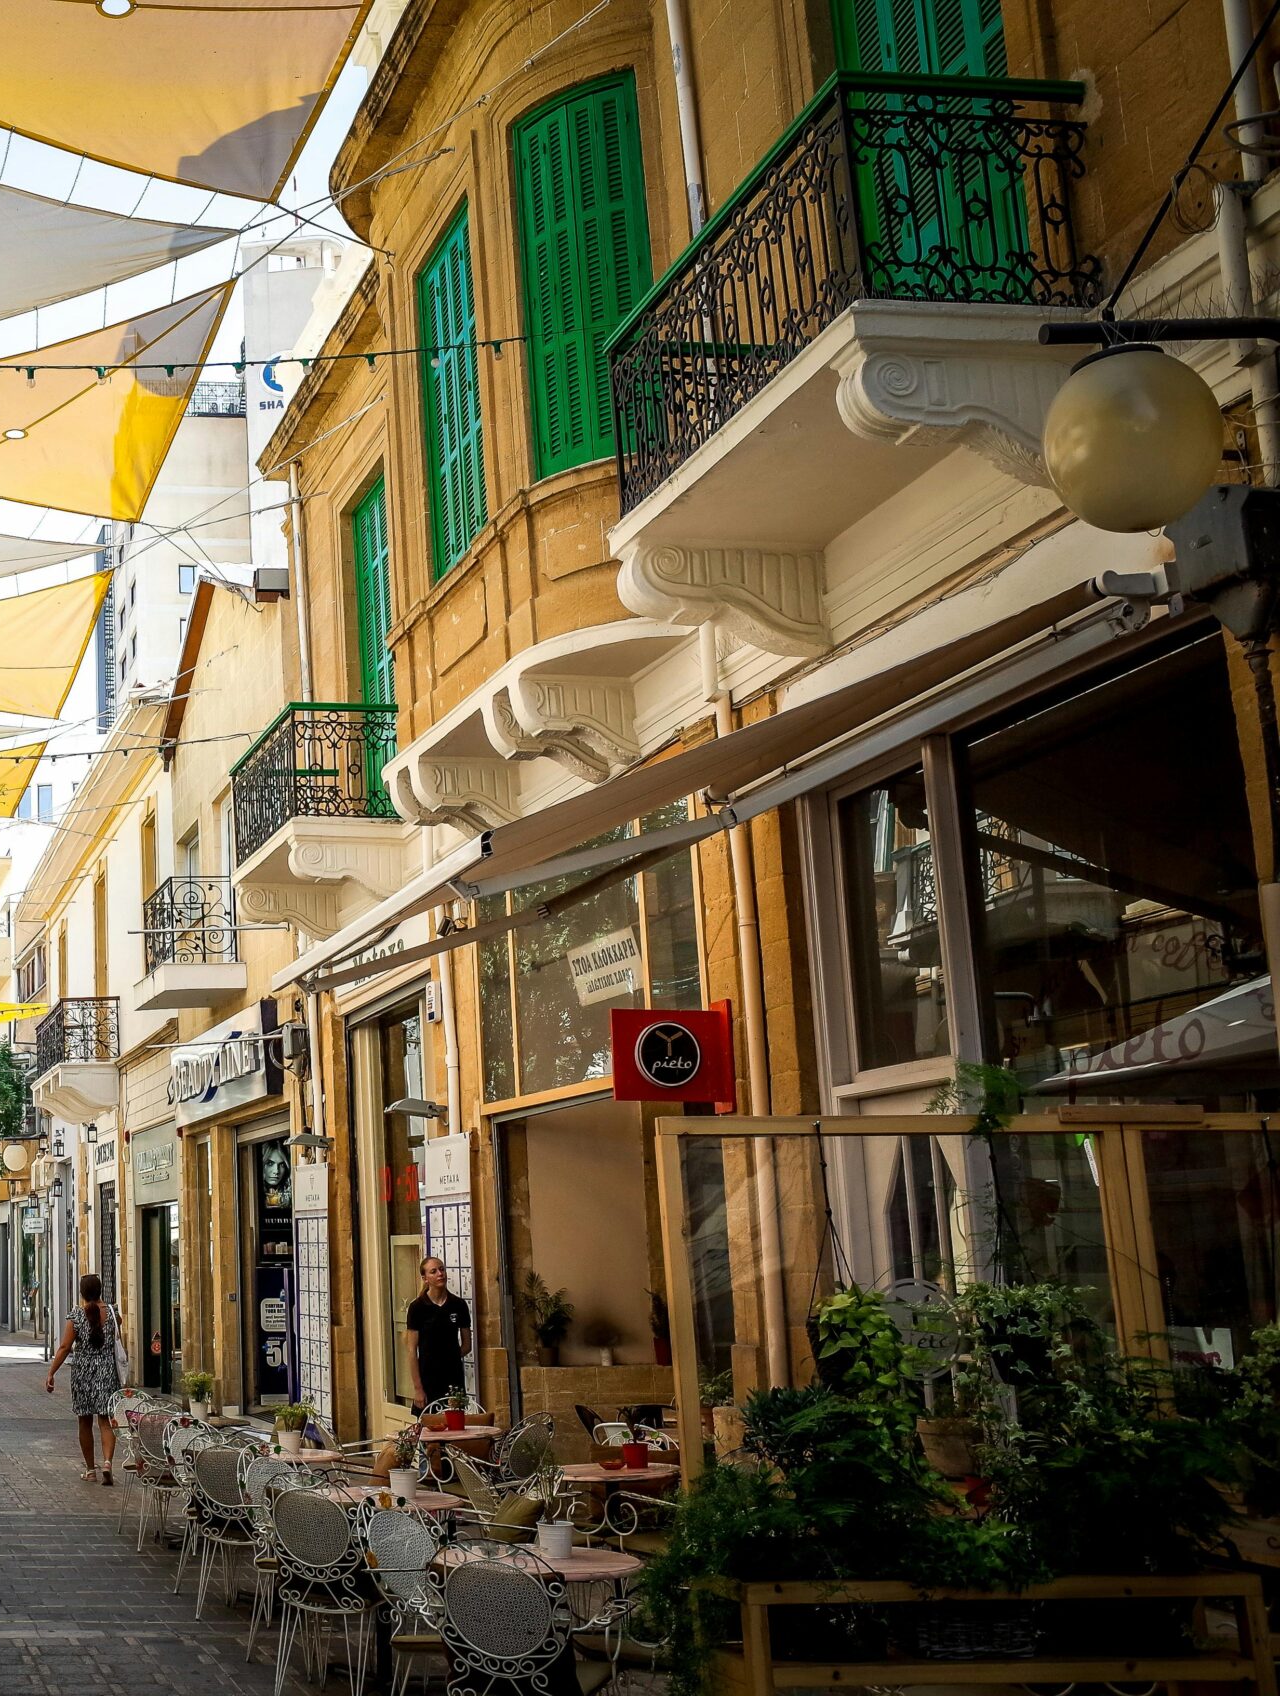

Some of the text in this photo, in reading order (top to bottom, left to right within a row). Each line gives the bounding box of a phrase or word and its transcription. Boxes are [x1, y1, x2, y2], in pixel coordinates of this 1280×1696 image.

[572, 937, 636, 977] ΣΤΟΑ ΚΛΟΚΚΑΡΗ
[652, 1056, 693, 1075] pieto
